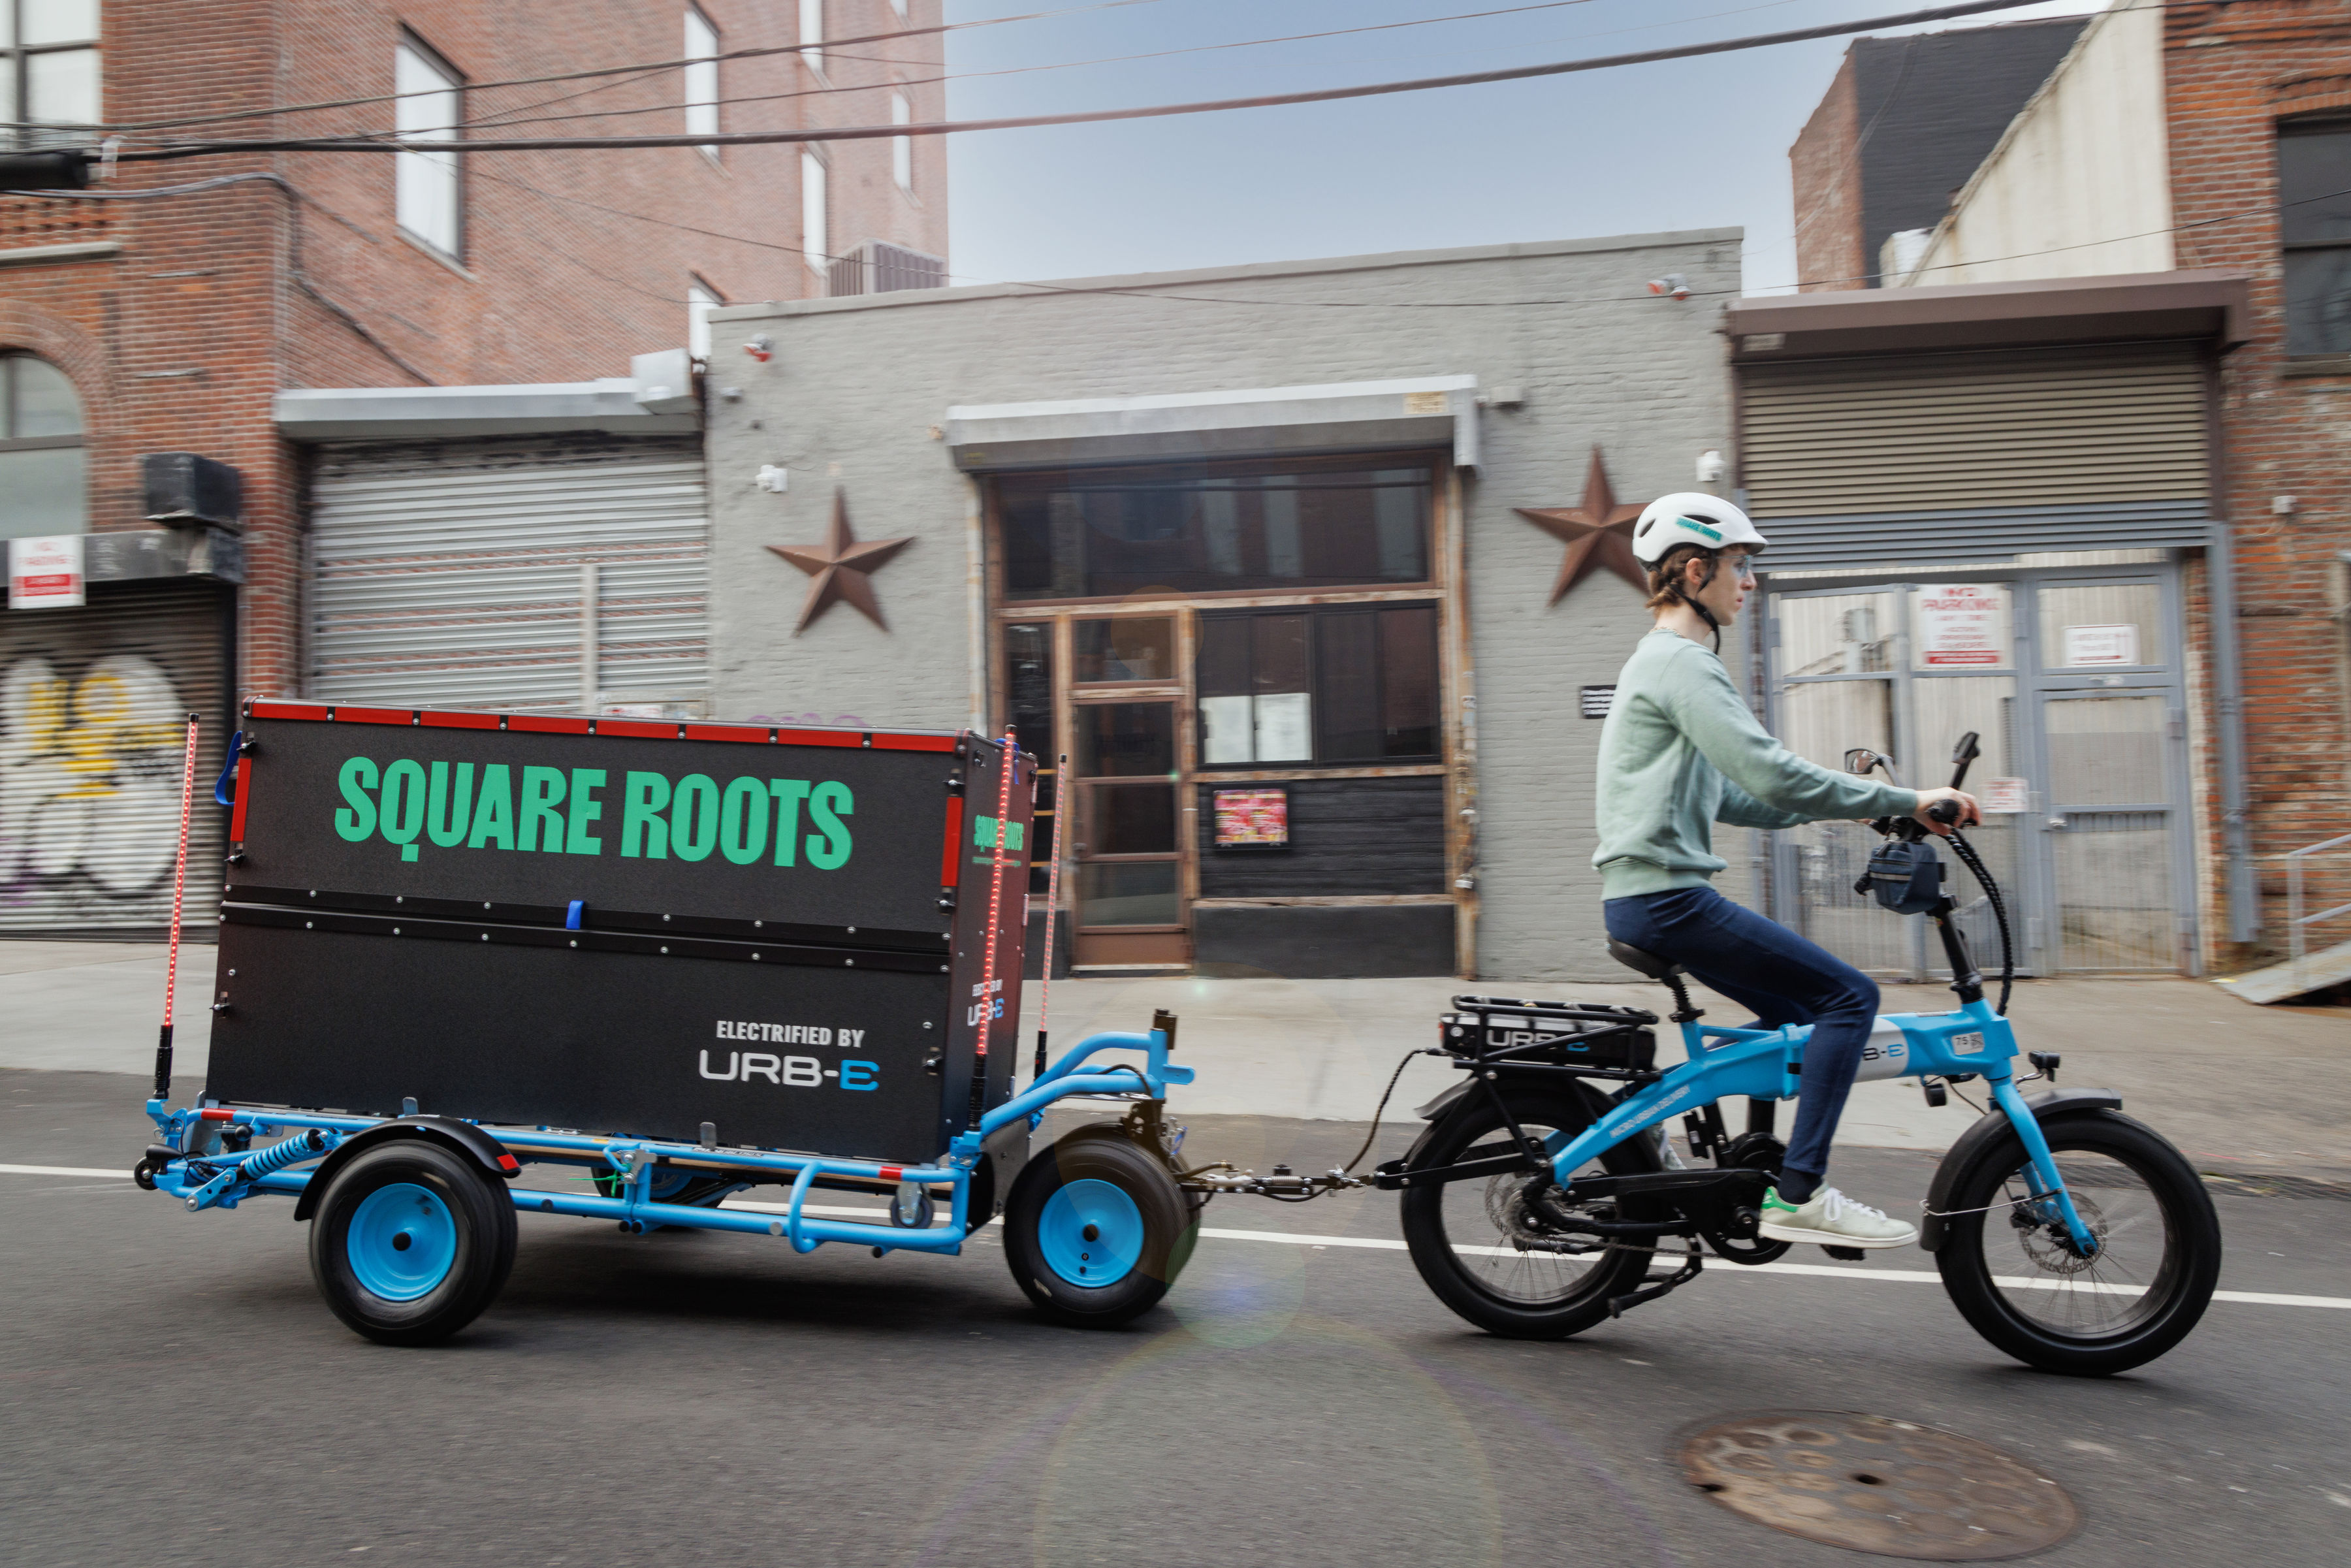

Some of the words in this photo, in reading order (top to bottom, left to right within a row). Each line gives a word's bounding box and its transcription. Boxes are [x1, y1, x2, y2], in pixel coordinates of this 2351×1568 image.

[335, 756, 607, 862] SQUARE
[621, 771, 854, 871] ROOTS
[716, 1020, 832, 1046] ELECTRIFIED
[838, 1029, 865, 1048] BY
[699, 1049, 880, 1091] URB-E
